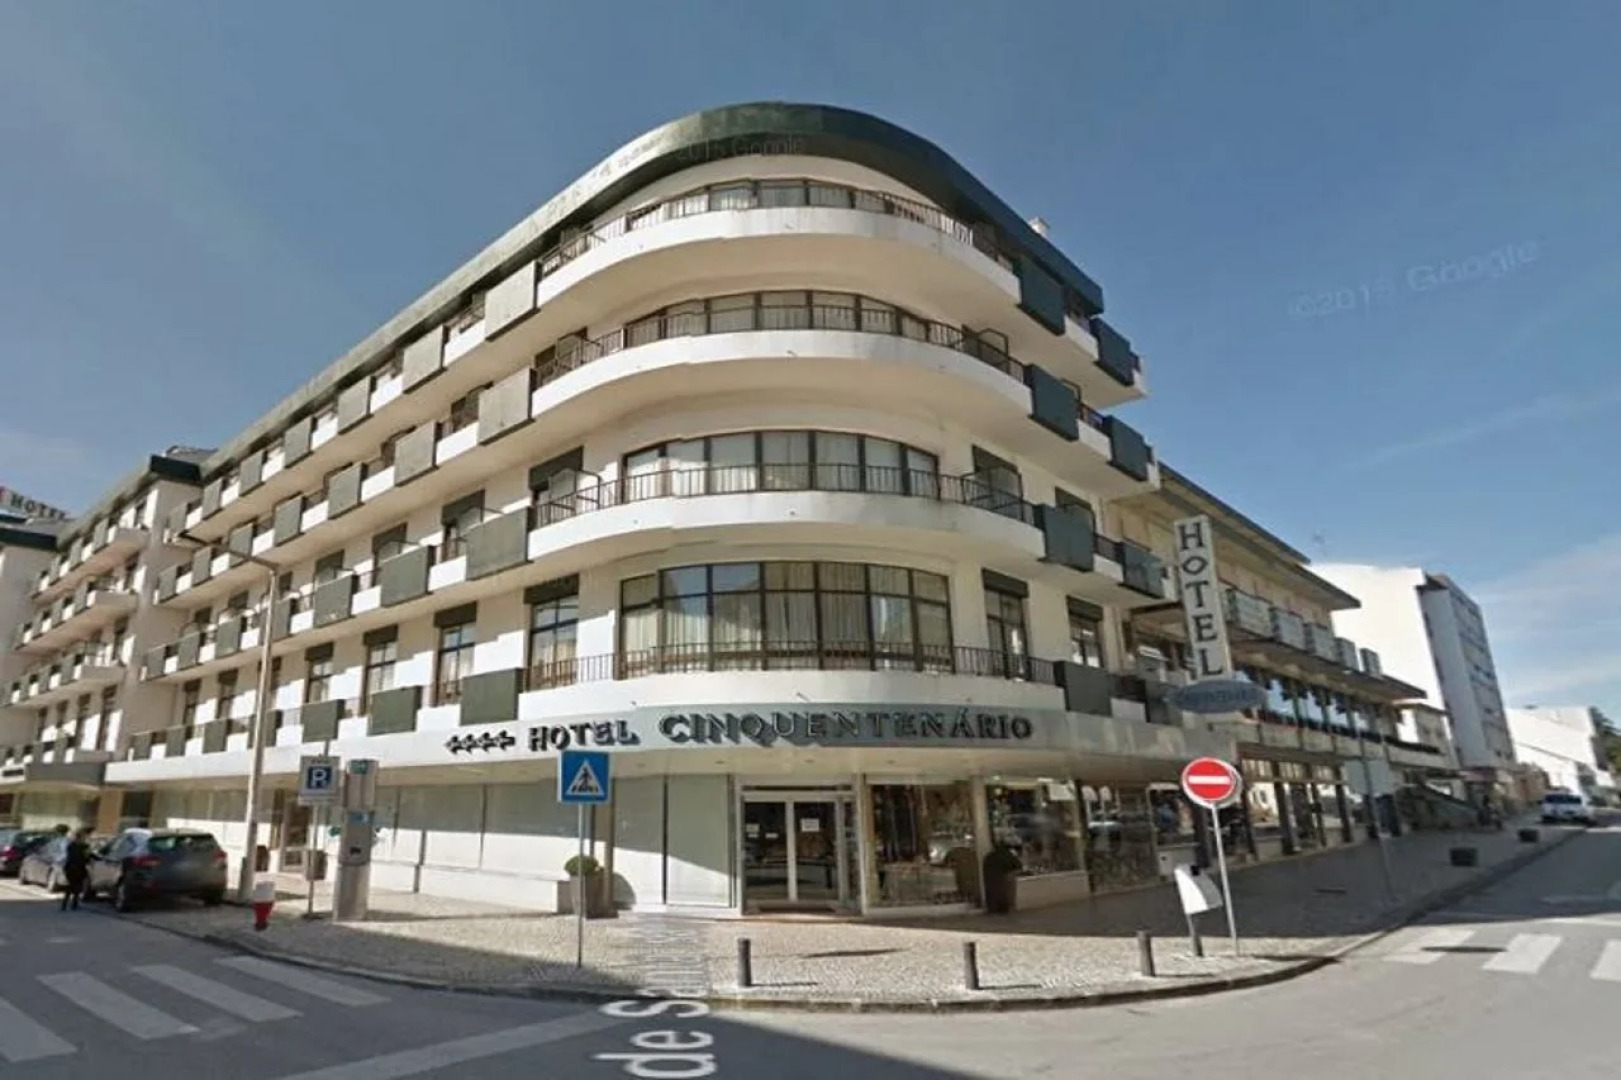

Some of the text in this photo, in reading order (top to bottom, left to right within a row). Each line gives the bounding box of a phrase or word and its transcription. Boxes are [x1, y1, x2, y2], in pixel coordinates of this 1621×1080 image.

[1178, 522, 1223, 676] HOTEL
[528, 708, 1034, 751] HOTEL CINQUENTENÁRIO
[310, 768, 328, 788] P
